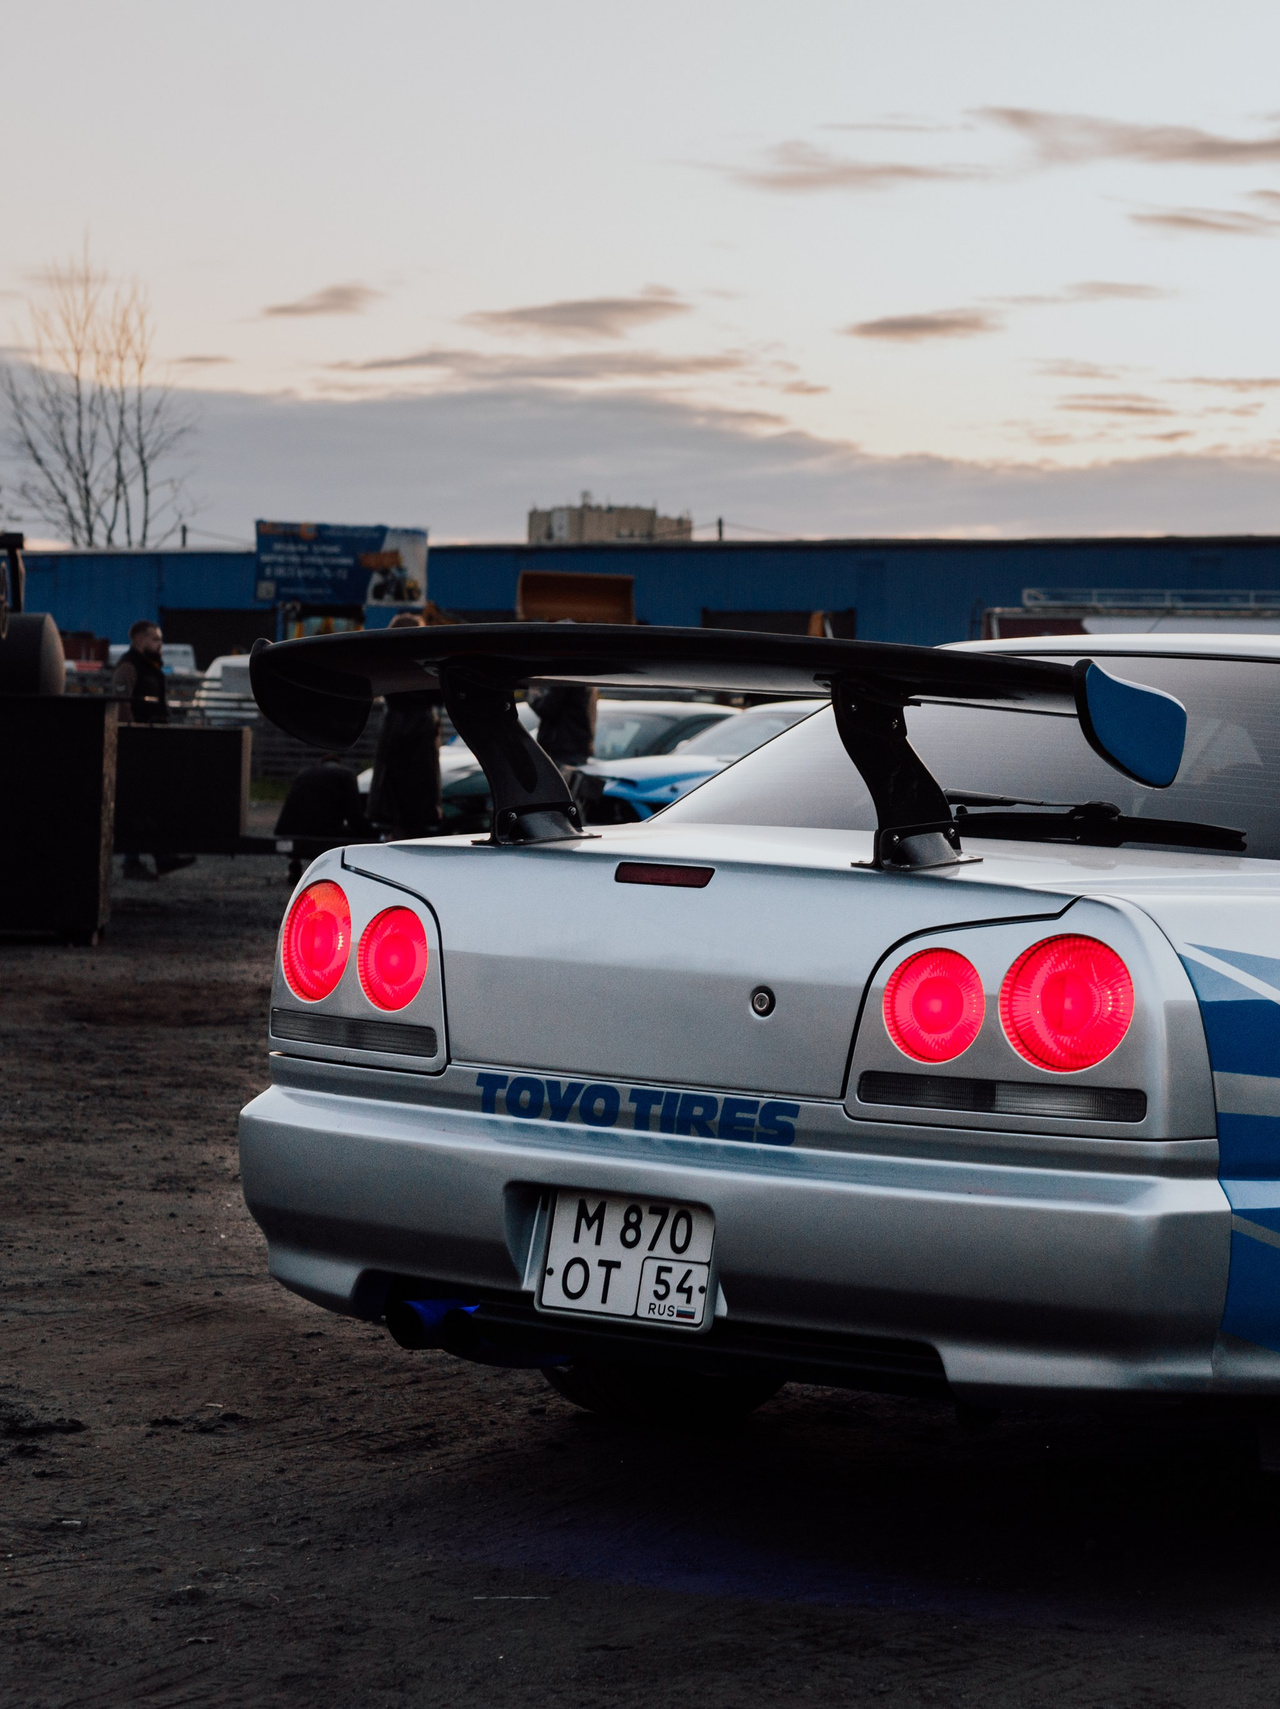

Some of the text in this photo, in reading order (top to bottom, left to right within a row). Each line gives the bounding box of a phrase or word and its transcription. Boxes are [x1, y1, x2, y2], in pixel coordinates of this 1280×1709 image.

[476, 1073, 800, 1147] TOYO TIRES
[573, 1199, 693, 1254] M 870
[562, 1257, 621, 1304] OT
[653, 1266, 693, 1304] 54
[648, 1303, 675, 1317] RUS
